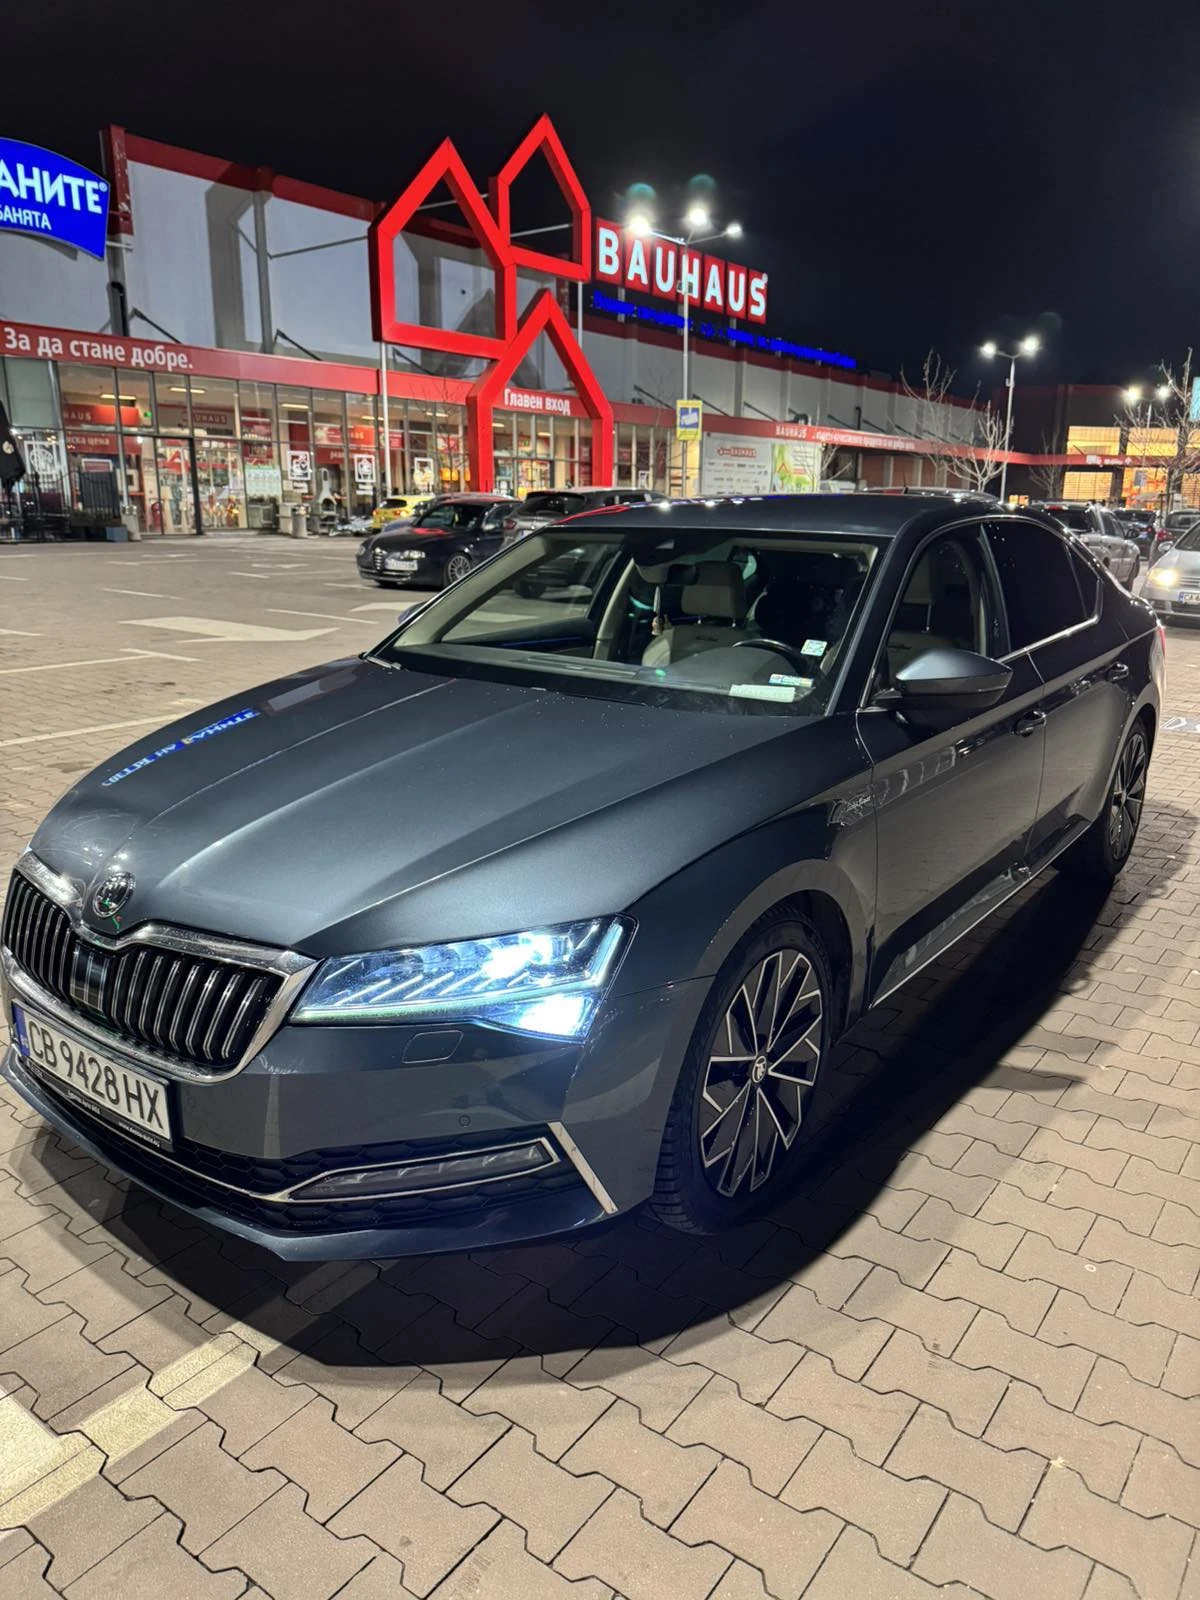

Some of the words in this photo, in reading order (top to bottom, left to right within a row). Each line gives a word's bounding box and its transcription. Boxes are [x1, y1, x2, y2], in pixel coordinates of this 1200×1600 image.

[0, 204, 52, 230] АНЯТА
[598, 227, 767, 316] BAUHAUS
[4, 327, 30, 350] За
[37, 336, 63, 357] да
[70, 340, 126, 361] стане
[131, 346, 193, 371] добре.
[504, 388, 543, 410] Главен
[545, 397, 571, 416] вход
[29, 1021, 58, 1068] CB
[60, 1040, 120, 1106] 9428
[123, 1074, 164, 1130] HX
